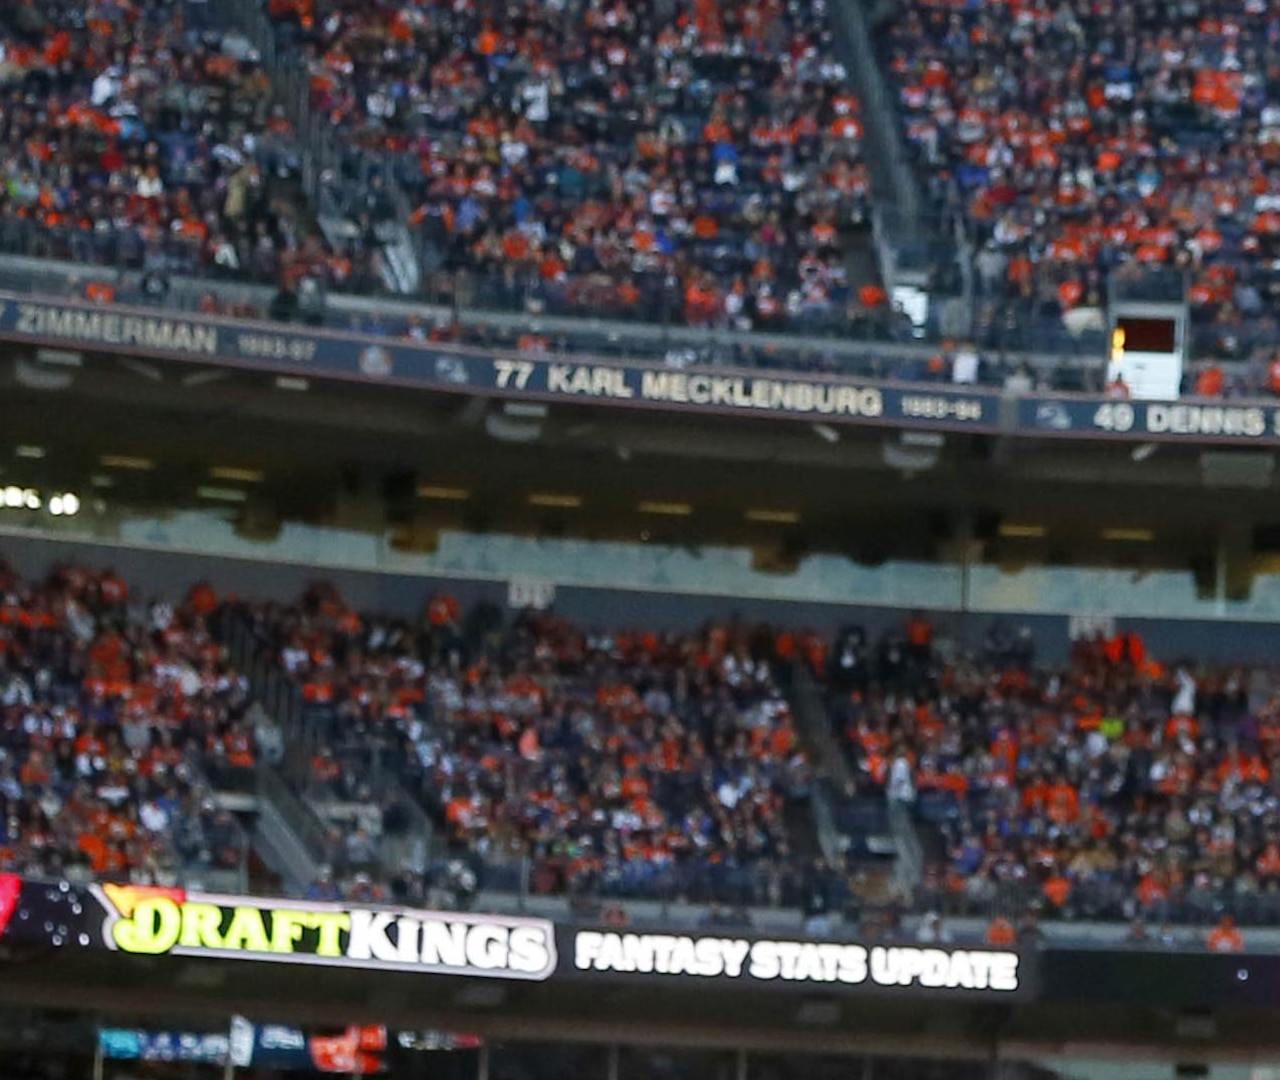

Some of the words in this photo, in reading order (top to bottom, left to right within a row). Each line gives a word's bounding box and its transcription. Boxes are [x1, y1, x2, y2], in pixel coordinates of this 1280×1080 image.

[15, 302, 218, 354] ZIMMERMAN
[494, 360, 534, 389] 77
[547, 365, 633, 399] KARL
[642, 371, 883, 417] MECKLENBURG
[1093, 403, 1134, 432] 49
[1146, 403, 1265, 437] DENNIS
[112, 896, 548, 973] DRAFTKINGS
[574, 932, 750, 978] FANTASY
[749, 941, 867, 984] STATS
[870, 947, 1020, 991] UPDATE
